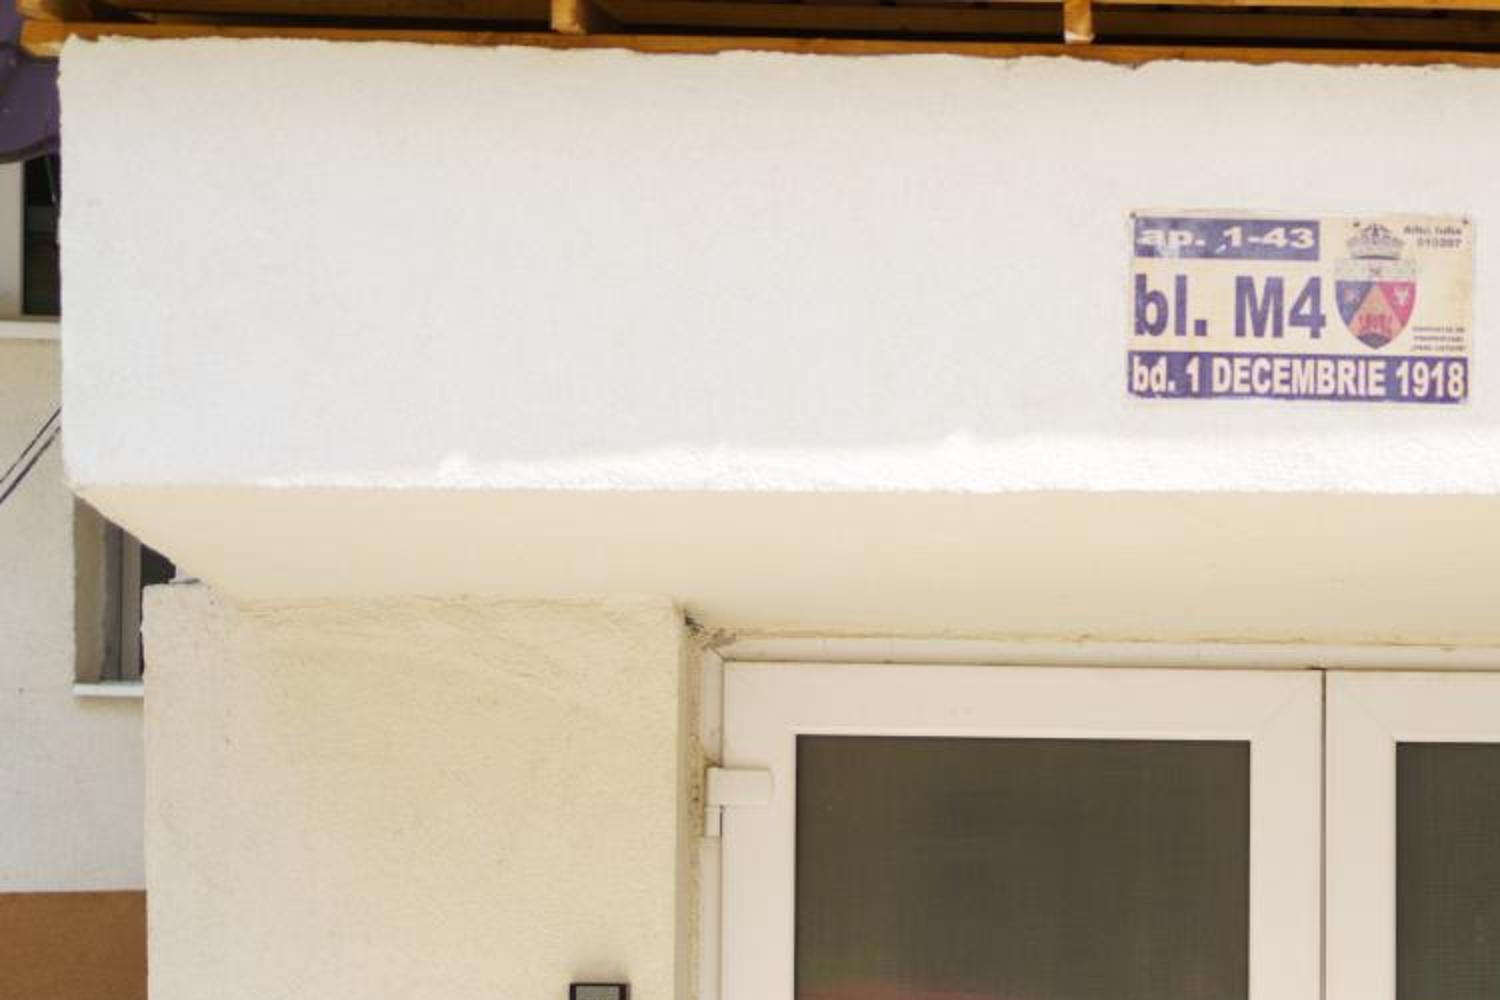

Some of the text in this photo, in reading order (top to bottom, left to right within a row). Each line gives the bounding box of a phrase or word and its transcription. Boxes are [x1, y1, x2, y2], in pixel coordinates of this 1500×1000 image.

[1136, 228, 1206, 256] ap.
[1134, 273, 1326, 339] bl. M4
[1132, 357, 1465, 398] bd. 1 DECEMBRIE 1918
